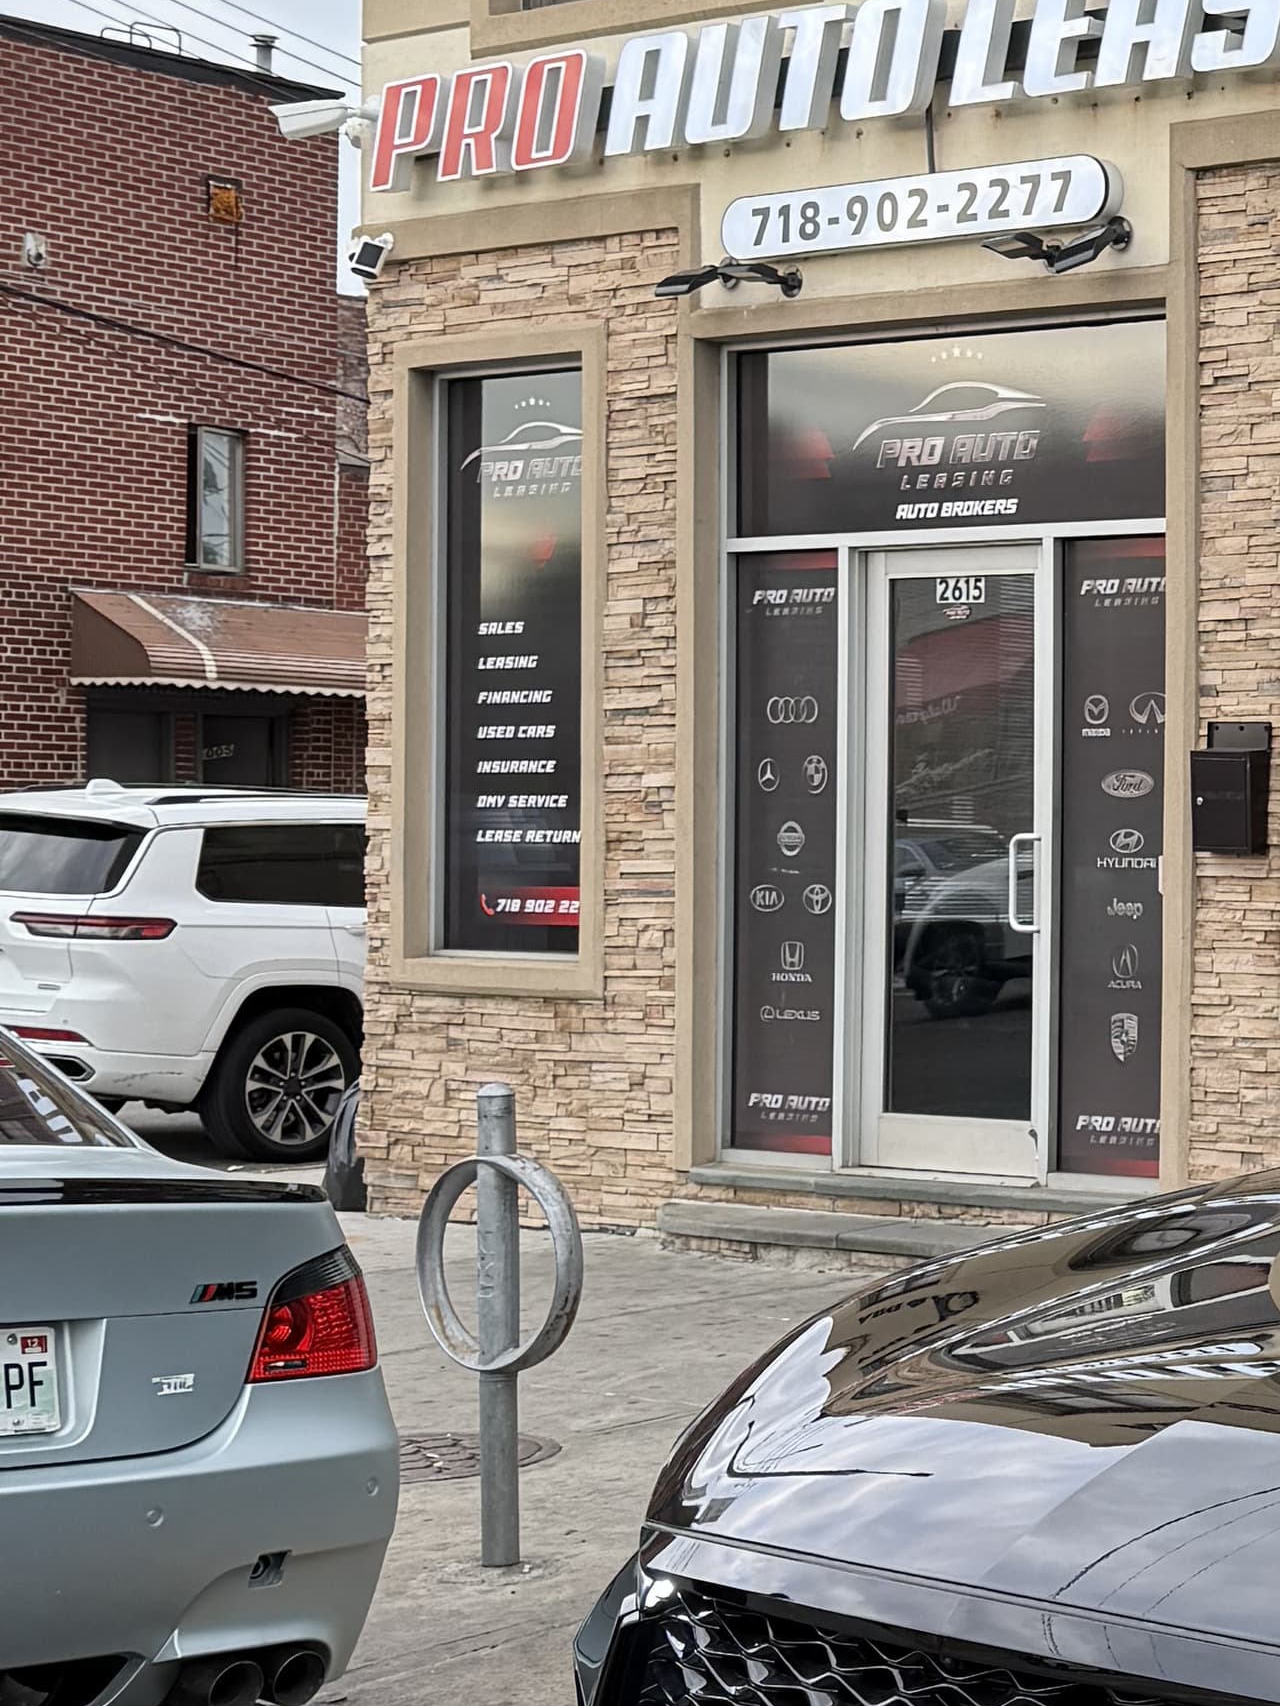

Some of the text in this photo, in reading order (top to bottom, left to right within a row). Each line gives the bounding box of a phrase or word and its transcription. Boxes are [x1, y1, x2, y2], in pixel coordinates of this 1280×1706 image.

[370, 49, 602, 191] PRO
[751, 170, 1074, 247] 718-902-2277
[876, 430, 1041, 469] PRO AUTO
[477, 460, 524, 483] PRO
[900, 469, 1015, 491] LEASING
[493, 482, 572, 498] LEASING
[895, 498, 1019, 520] AUTO BROKERS
[938, 578, 983, 601] 2615
[1080, 579, 1120, 595] PRO
[752, 587, 836, 605] PRO AUTO
[478, 621, 525, 636] SALES
[478, 655, 538, 670] LEASING
[477, 690, 552, 704] FINANCING
[477, 724, 556, 739] USED CARS
[477, 760, 556, 774] INSURANCE
[477, 794, 569, 808] DMV SERVICE
[476, 829, 523, 843] LEASE
[1096, 857, 1157, 869] HYUNDAI
[495, 898, 521, 913] 718
[524, 899, 556, 913] 902
[1107, 898, 1143, 919] Jeep
[771, 972, 812, 982] HONDA
[776, 1009, 820, 1021] LEXUS
[748, 1093, 831, 1111] PRO AUTO
[1076, 1115, 1116, 1132] PRO
[4, 1361, 48, 1409] PF
